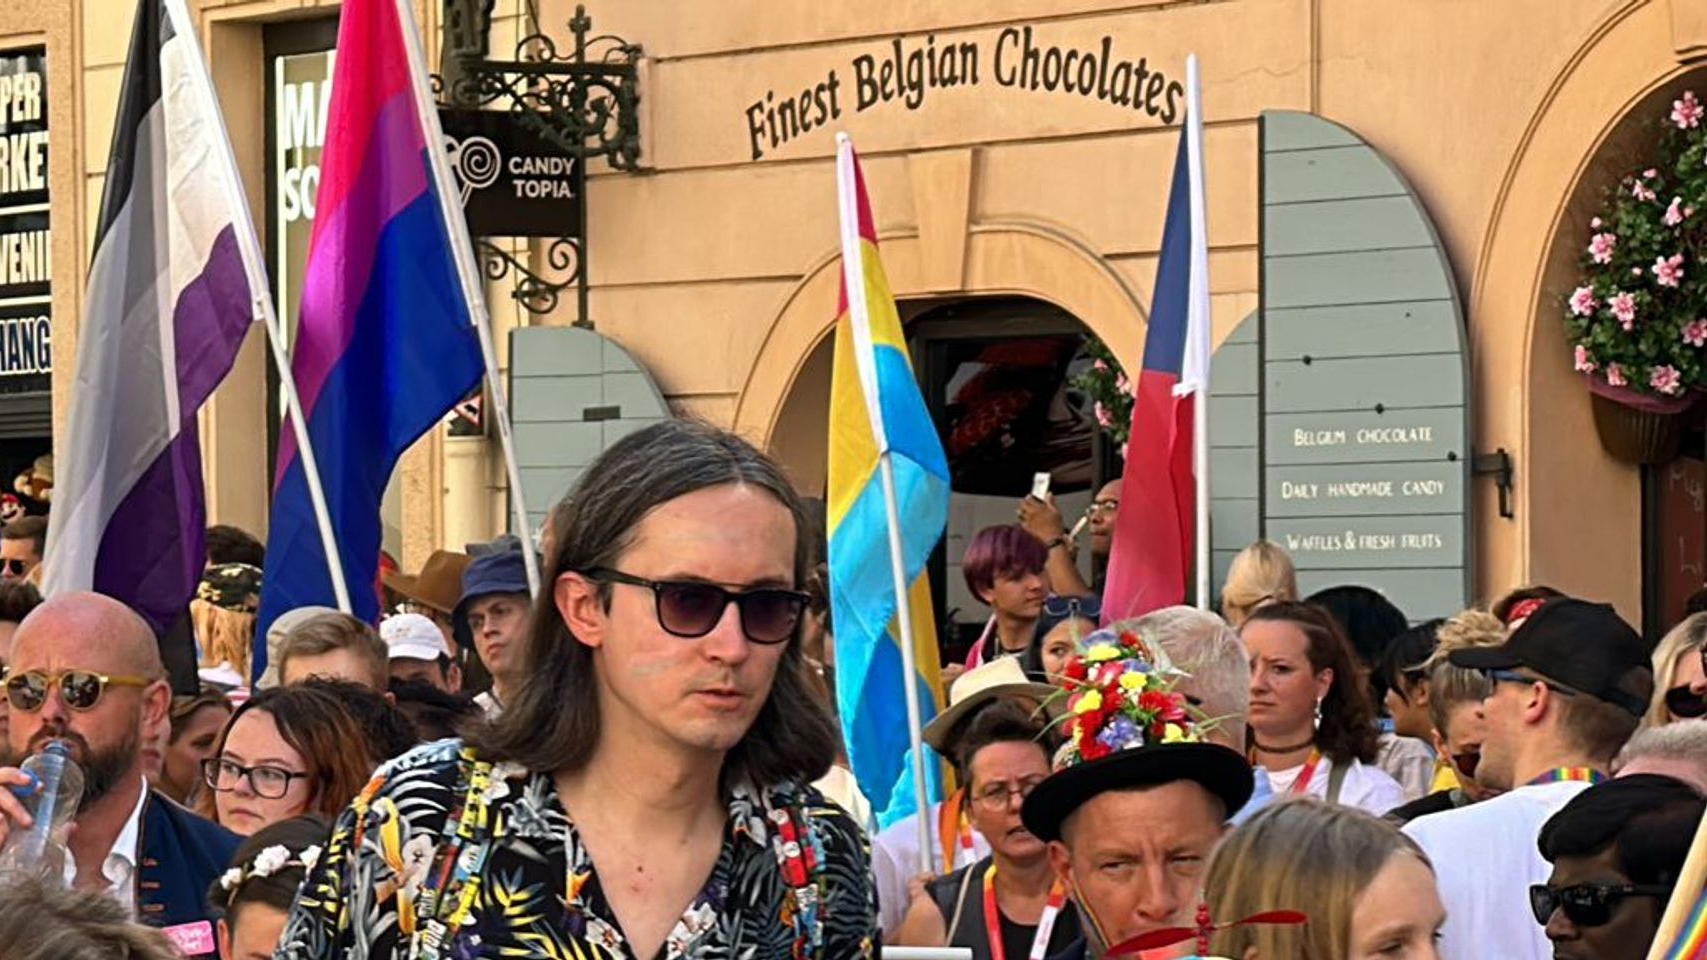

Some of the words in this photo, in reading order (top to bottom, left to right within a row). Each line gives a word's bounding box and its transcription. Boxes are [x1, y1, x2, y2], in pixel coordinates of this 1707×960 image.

[745, 69, 842, 161] Finest
[852, 33, 979, 111] Belgian
[994, 26, 1184, 125] Chocolates
[508, 156, 575, 175] CANDY
[512, 179, 572, 198] TOPIA
[1357, 426, 1432, 444] CHOCOLATE
[1328, 481, 1393, 497] HANDMADE
[1402, 479, 1443, 495] CANDY
[1344, 530, 1355, 550] &
